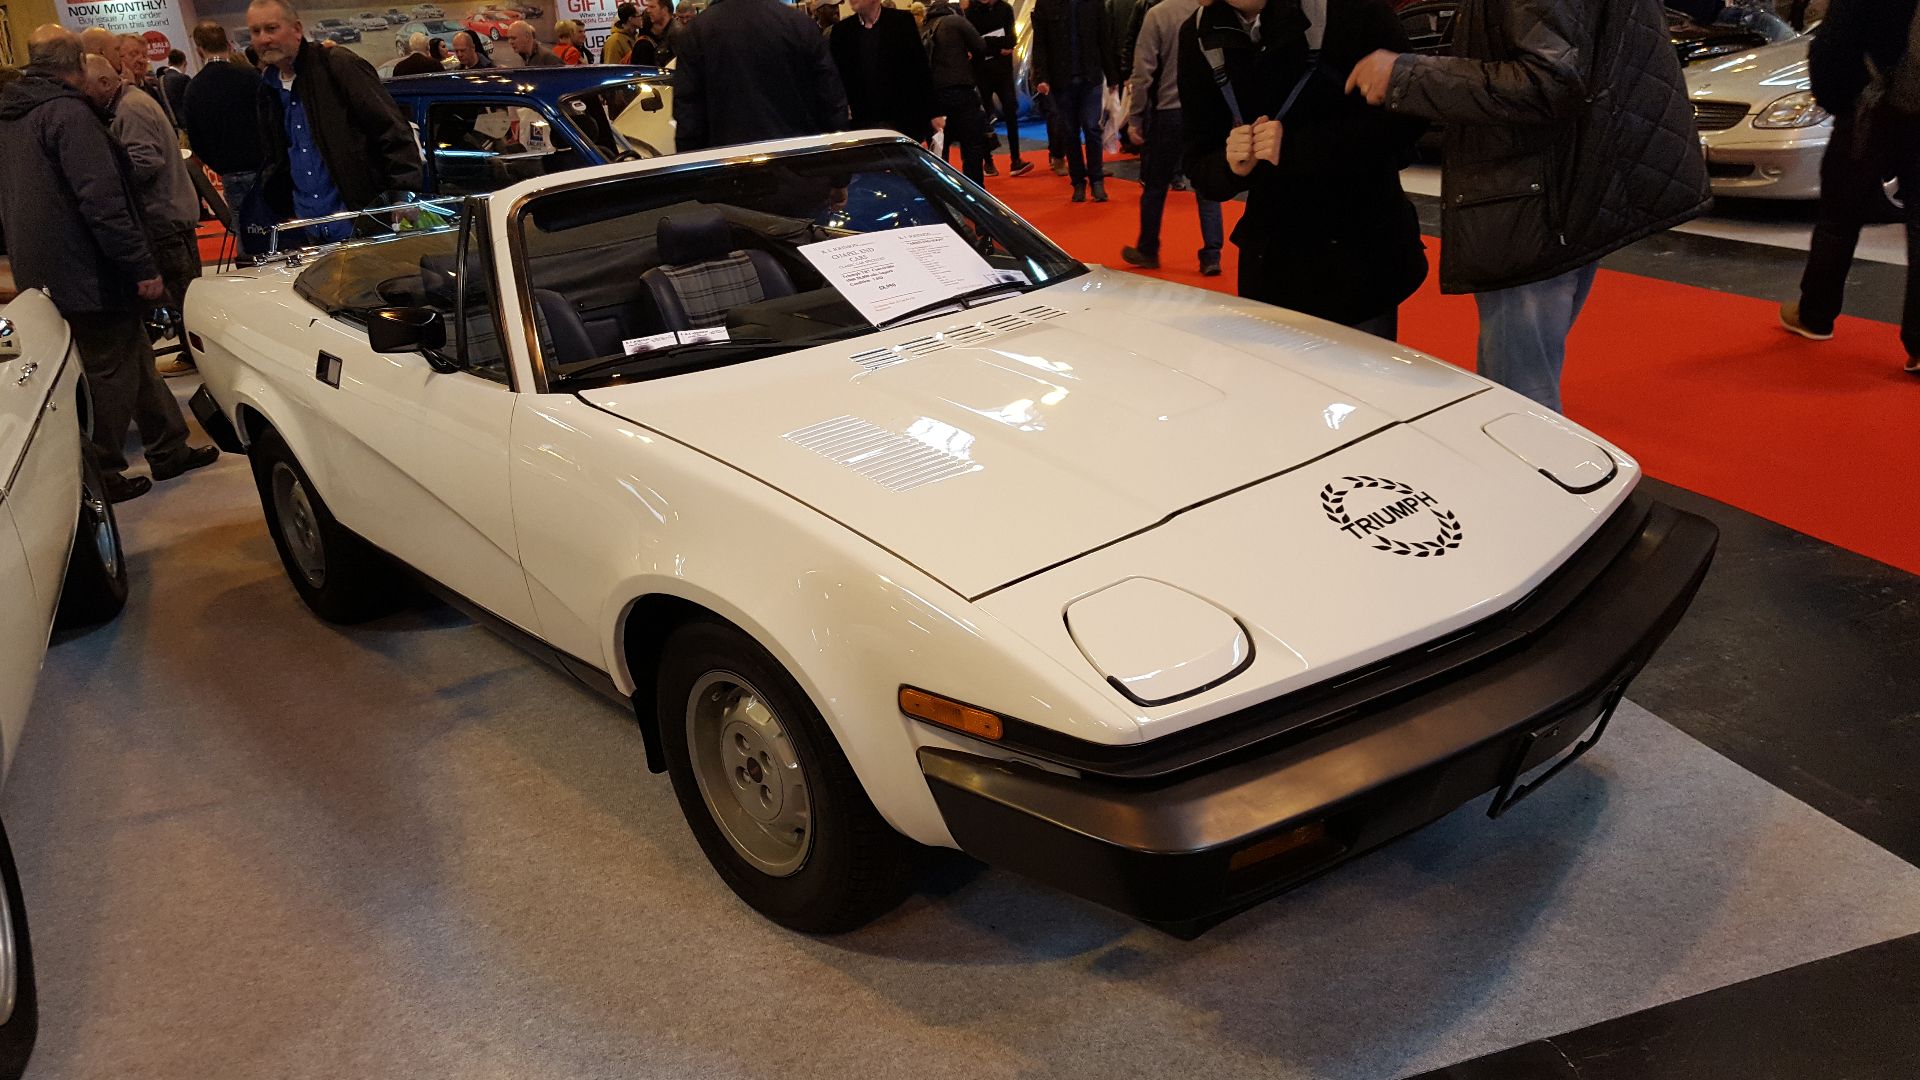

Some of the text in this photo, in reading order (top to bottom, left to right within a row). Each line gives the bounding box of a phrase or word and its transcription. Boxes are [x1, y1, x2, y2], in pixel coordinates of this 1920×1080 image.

[68, 0, 168, 17] NOW MONTHLY!
[568, 0, 605, 12] GIFT
[79, 17, 94, 25] Buy
[97, 15, 118, 23] issue
[119, 13, 125, 21] 7
[140, 11, 161, 19] order
[130, 20, 145, 28] this
[147, 18, 170, 27] stand
[1340, 491, 1439, 540] TRIUMPH
